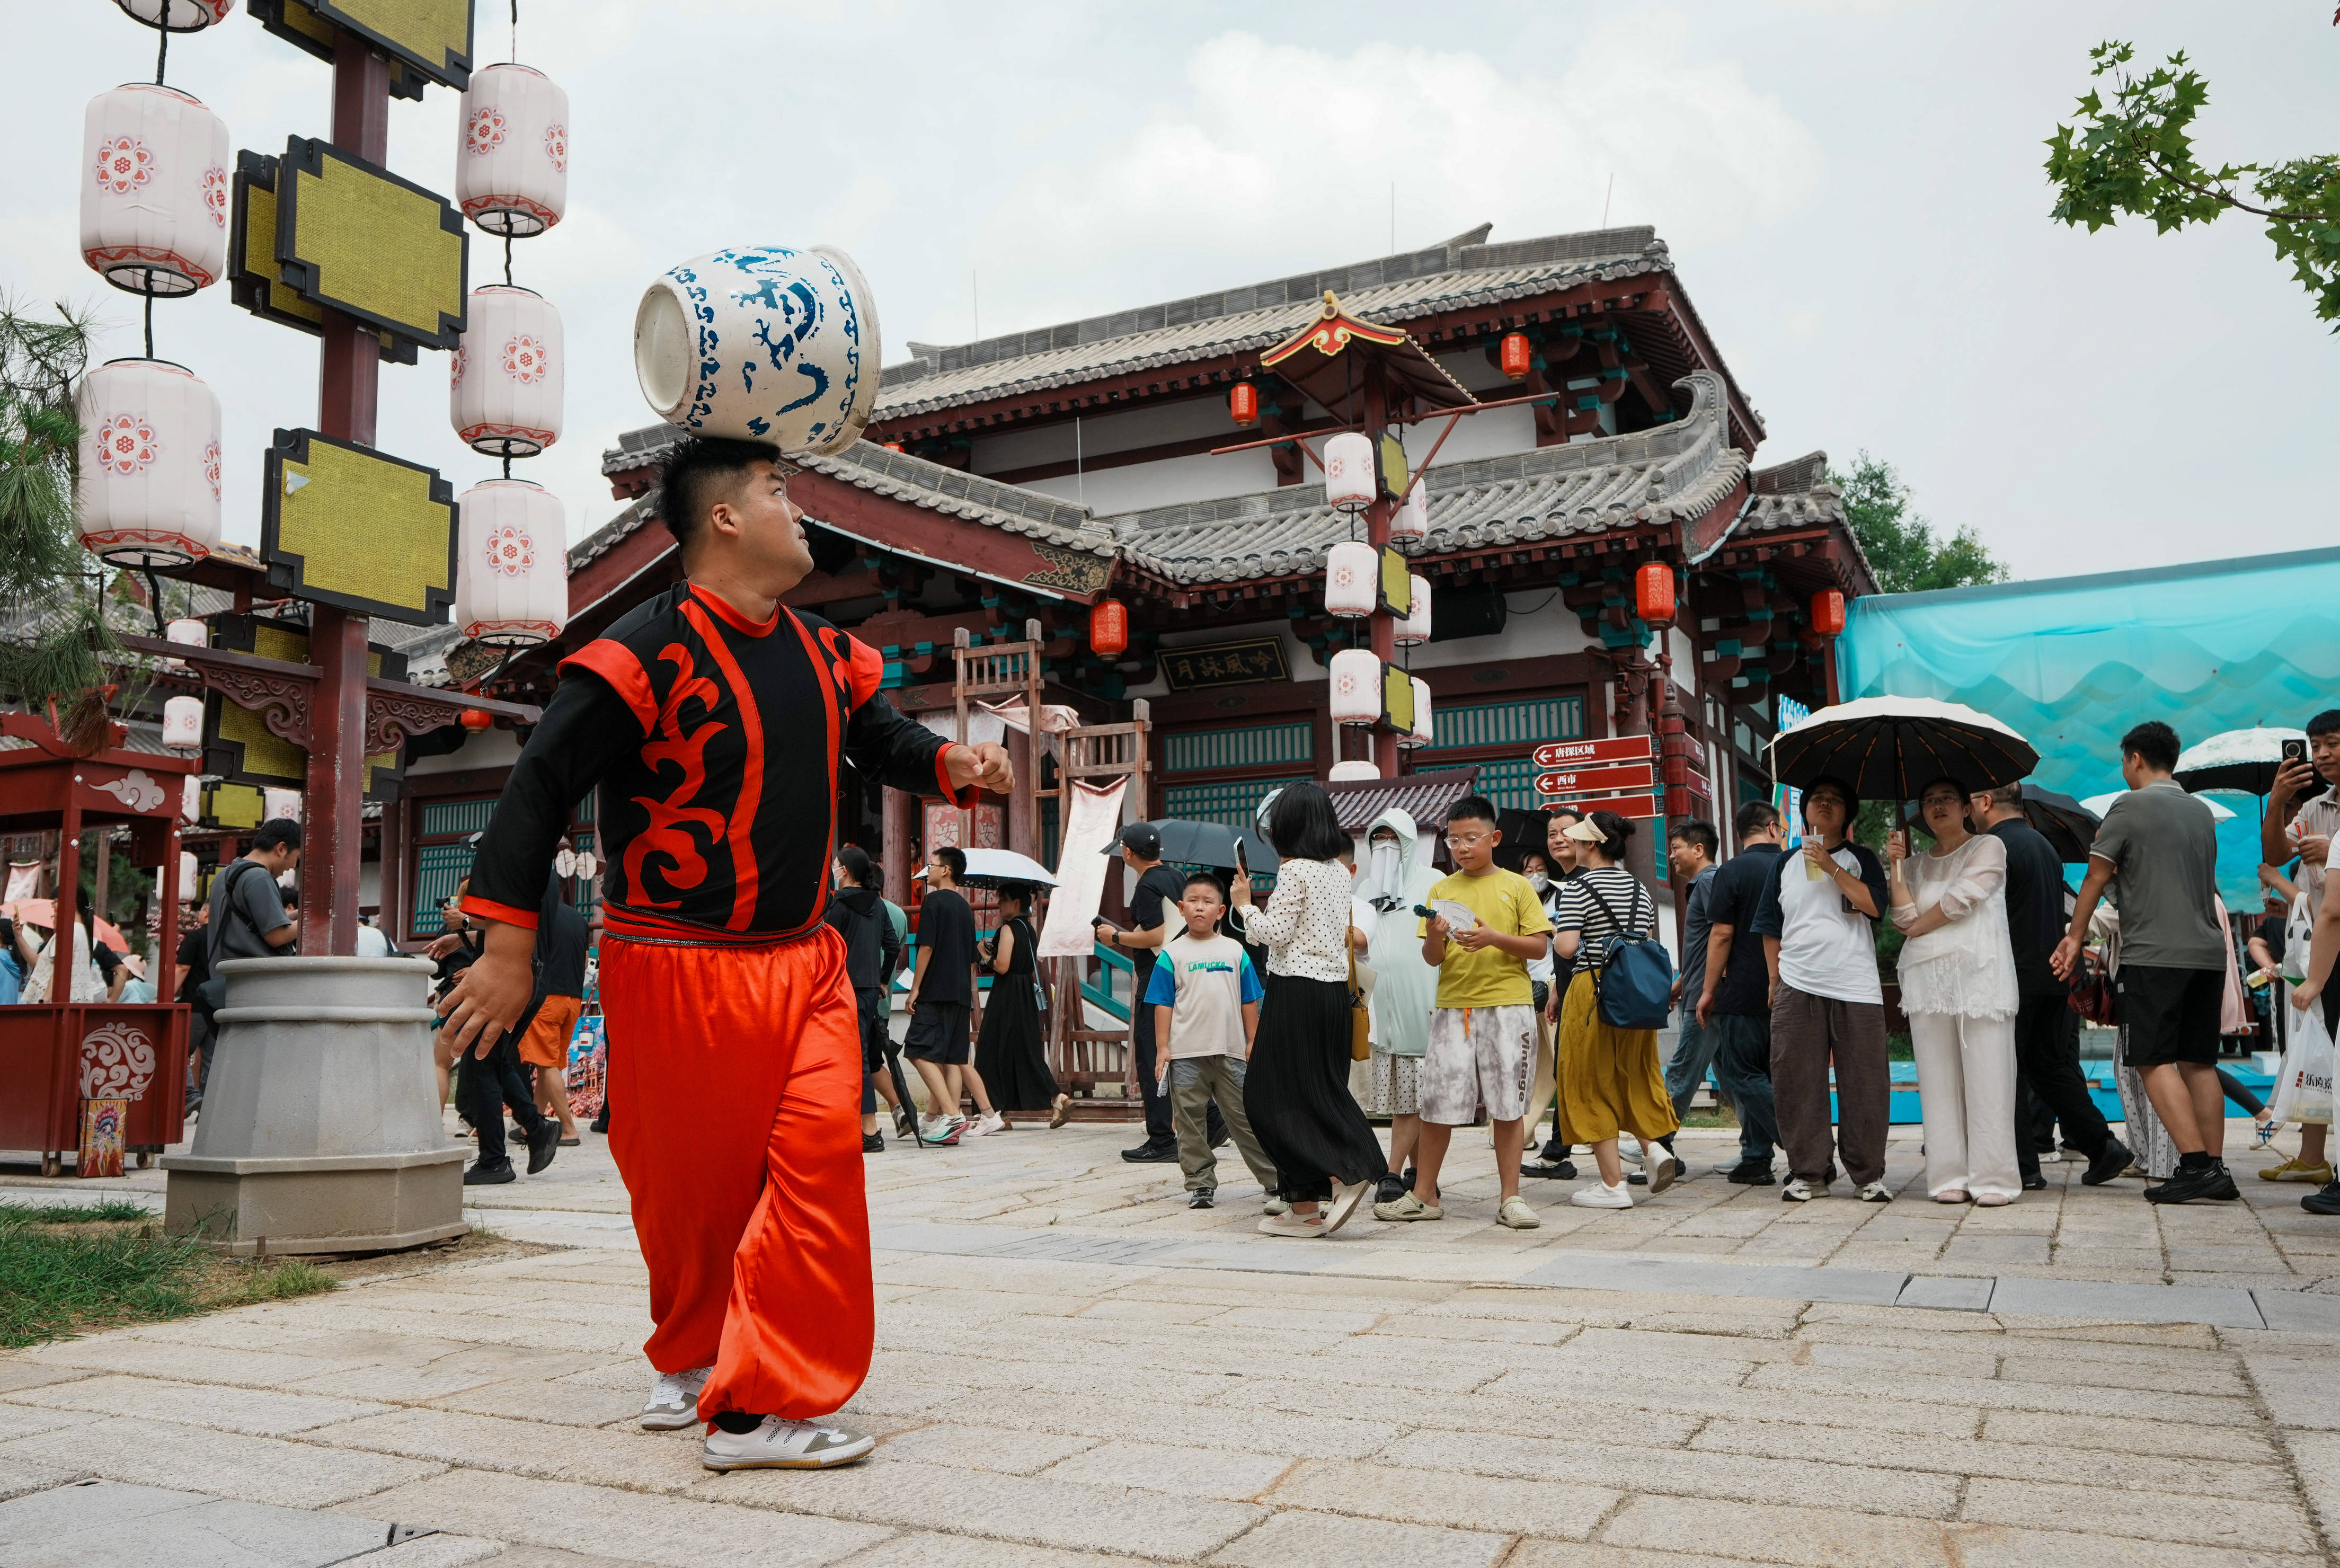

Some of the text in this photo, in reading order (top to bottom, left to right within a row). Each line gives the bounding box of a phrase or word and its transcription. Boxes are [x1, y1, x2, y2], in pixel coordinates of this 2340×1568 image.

[1555, 744, 1595, 758] 唐探区域
[1557, 774, 1576, 785] 西市
[937, 821, 958, 843] 安
[980, 821, 995, 844] 安
[1518, 1032, 1530, 1102] Vintage
